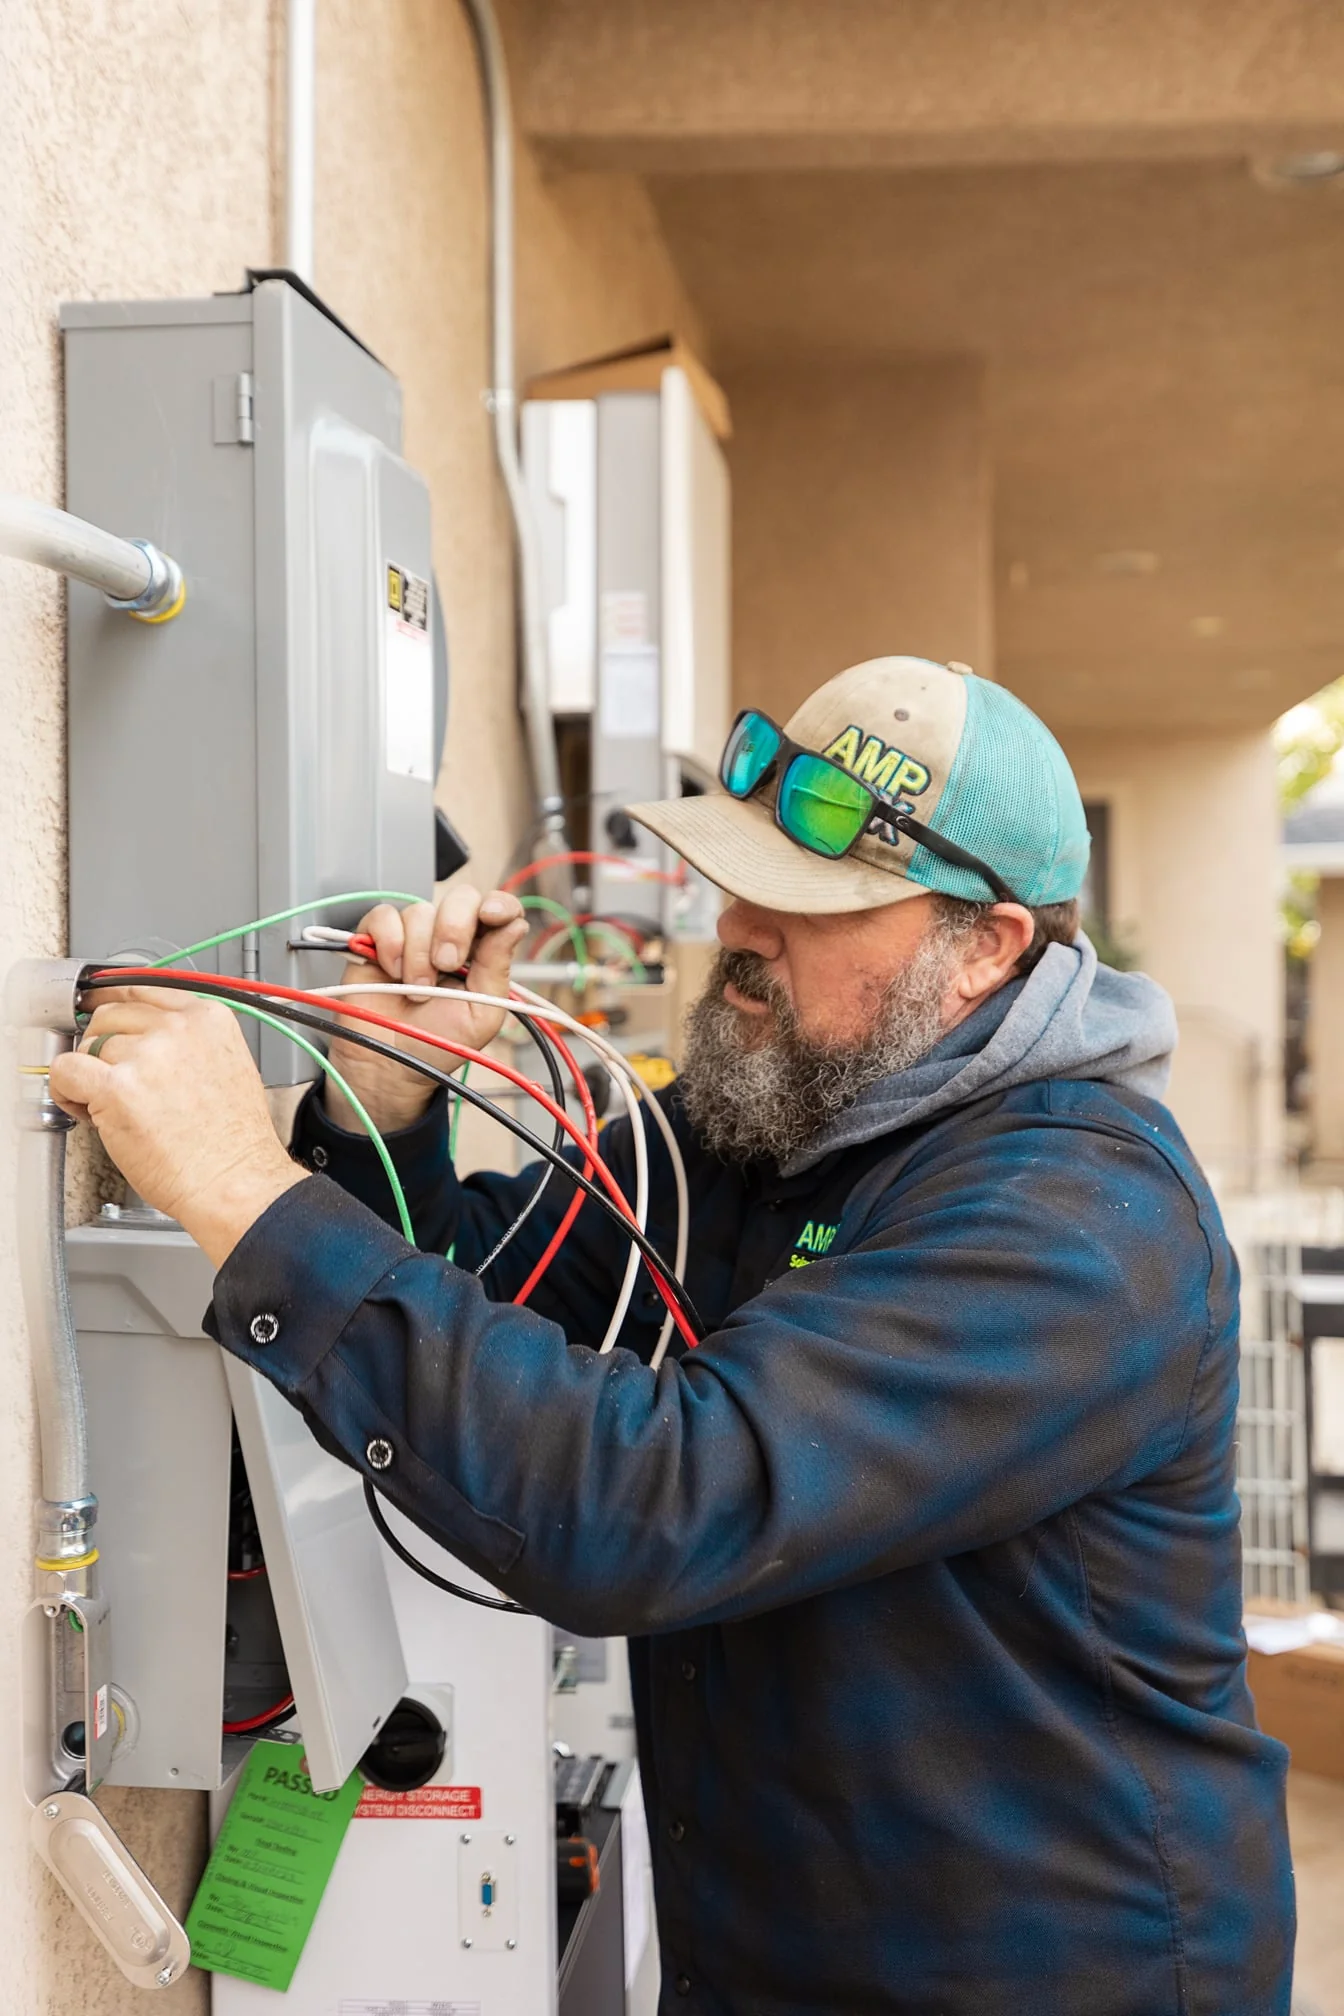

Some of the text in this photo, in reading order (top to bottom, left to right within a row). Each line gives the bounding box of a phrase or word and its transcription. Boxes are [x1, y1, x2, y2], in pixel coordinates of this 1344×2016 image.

[822, 725, 931, 798] AMP
[263, 1765, 339, 1802] PASSD
[406, 1788, 471, 1801] STORAGE
[396, 1804, 476, 1817] DISCONNECT
